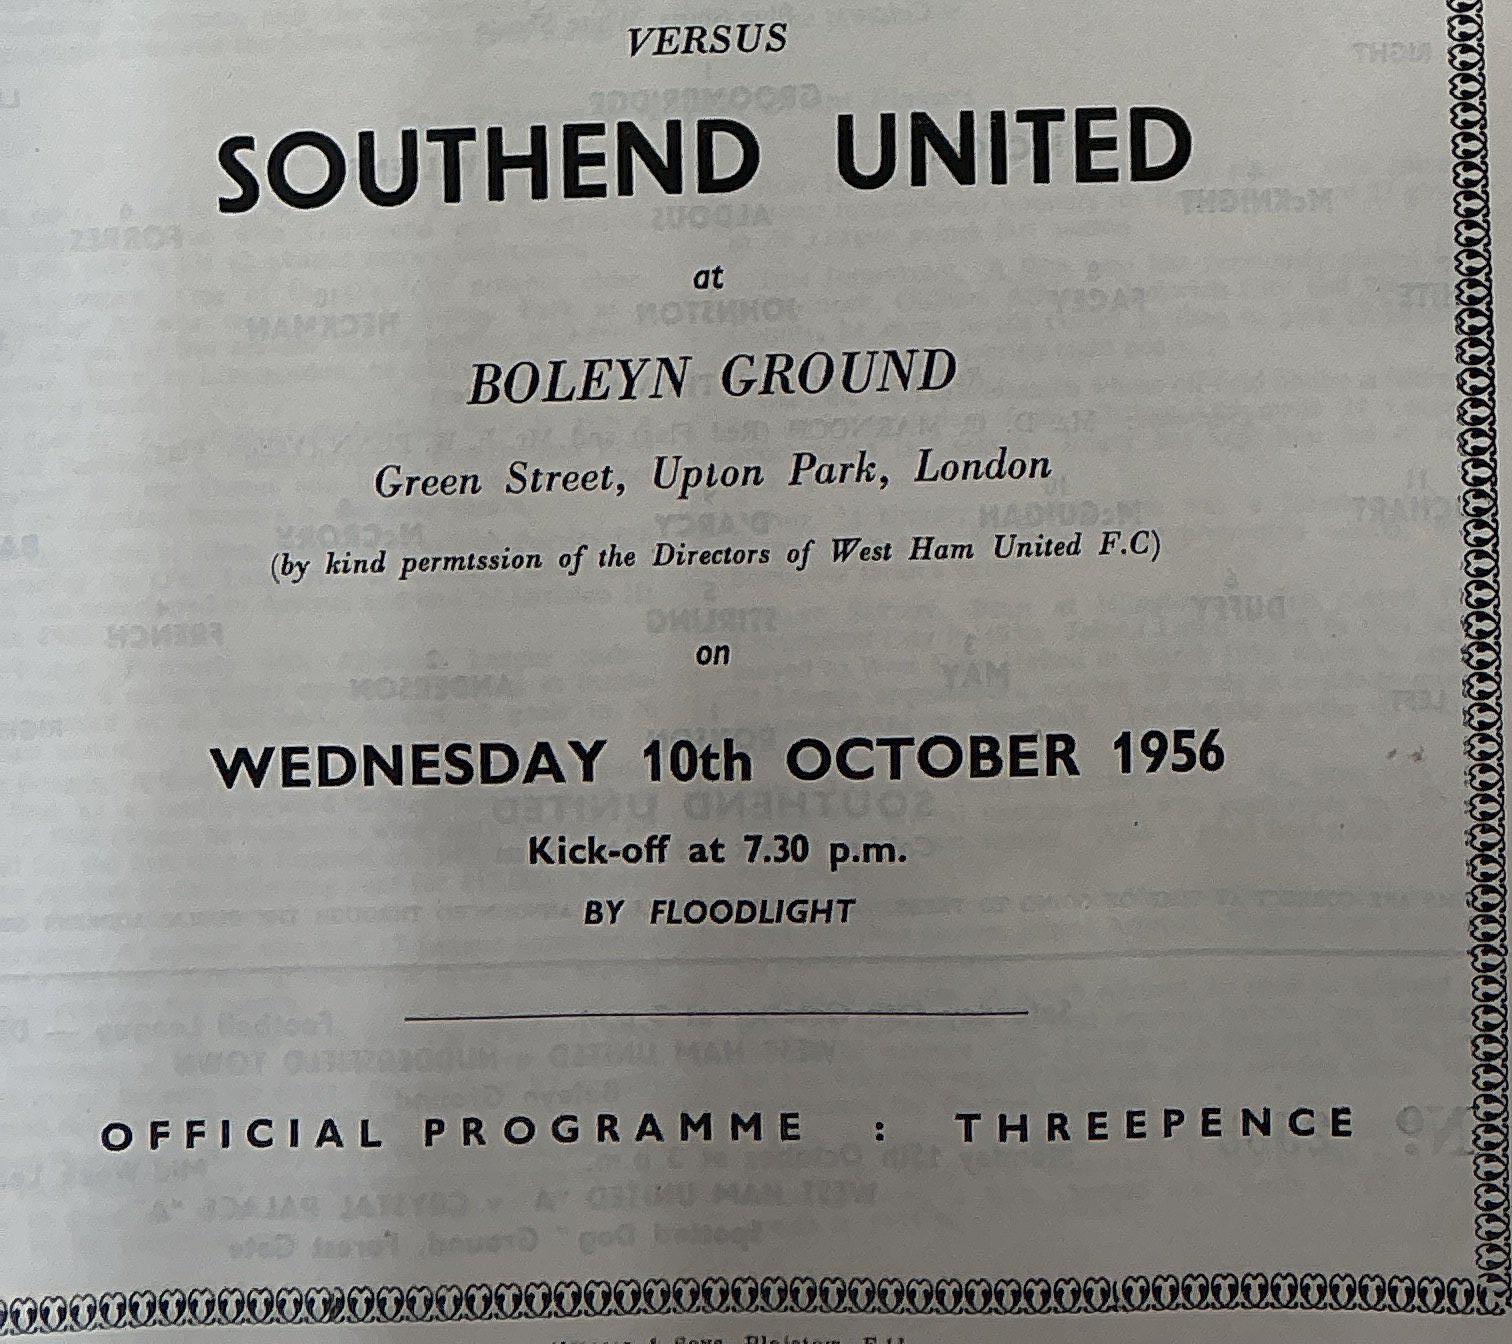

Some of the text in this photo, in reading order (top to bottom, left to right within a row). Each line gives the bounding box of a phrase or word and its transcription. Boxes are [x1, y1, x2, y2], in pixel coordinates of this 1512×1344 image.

[627, 22, 788, 58] VERSUS
[218, 106, 1193, 214] SOUTHEND UNITED
[692, 264, 725, 291] at
[465, 347, 957, 406] BOLEYN GROUND
[375, 464, 483, 498] Green
[505, 460, 625, 497] Street,
[787, 449, 889, 491] Park,
[913, 445, 1053, 483] London
[695, 644, 731, 667] on
[209, 727, 1225, 790] WEDNESDAY 10th OCTOBER 1956
[528, 833, 907, 873] Kick-off at 7.30 p.m.
[584, 897, 857, 926] BY FLOODLIGHT
[100, 1105, 1353, 1153] OFFICIAL PROGRAMME THREEPENCE
